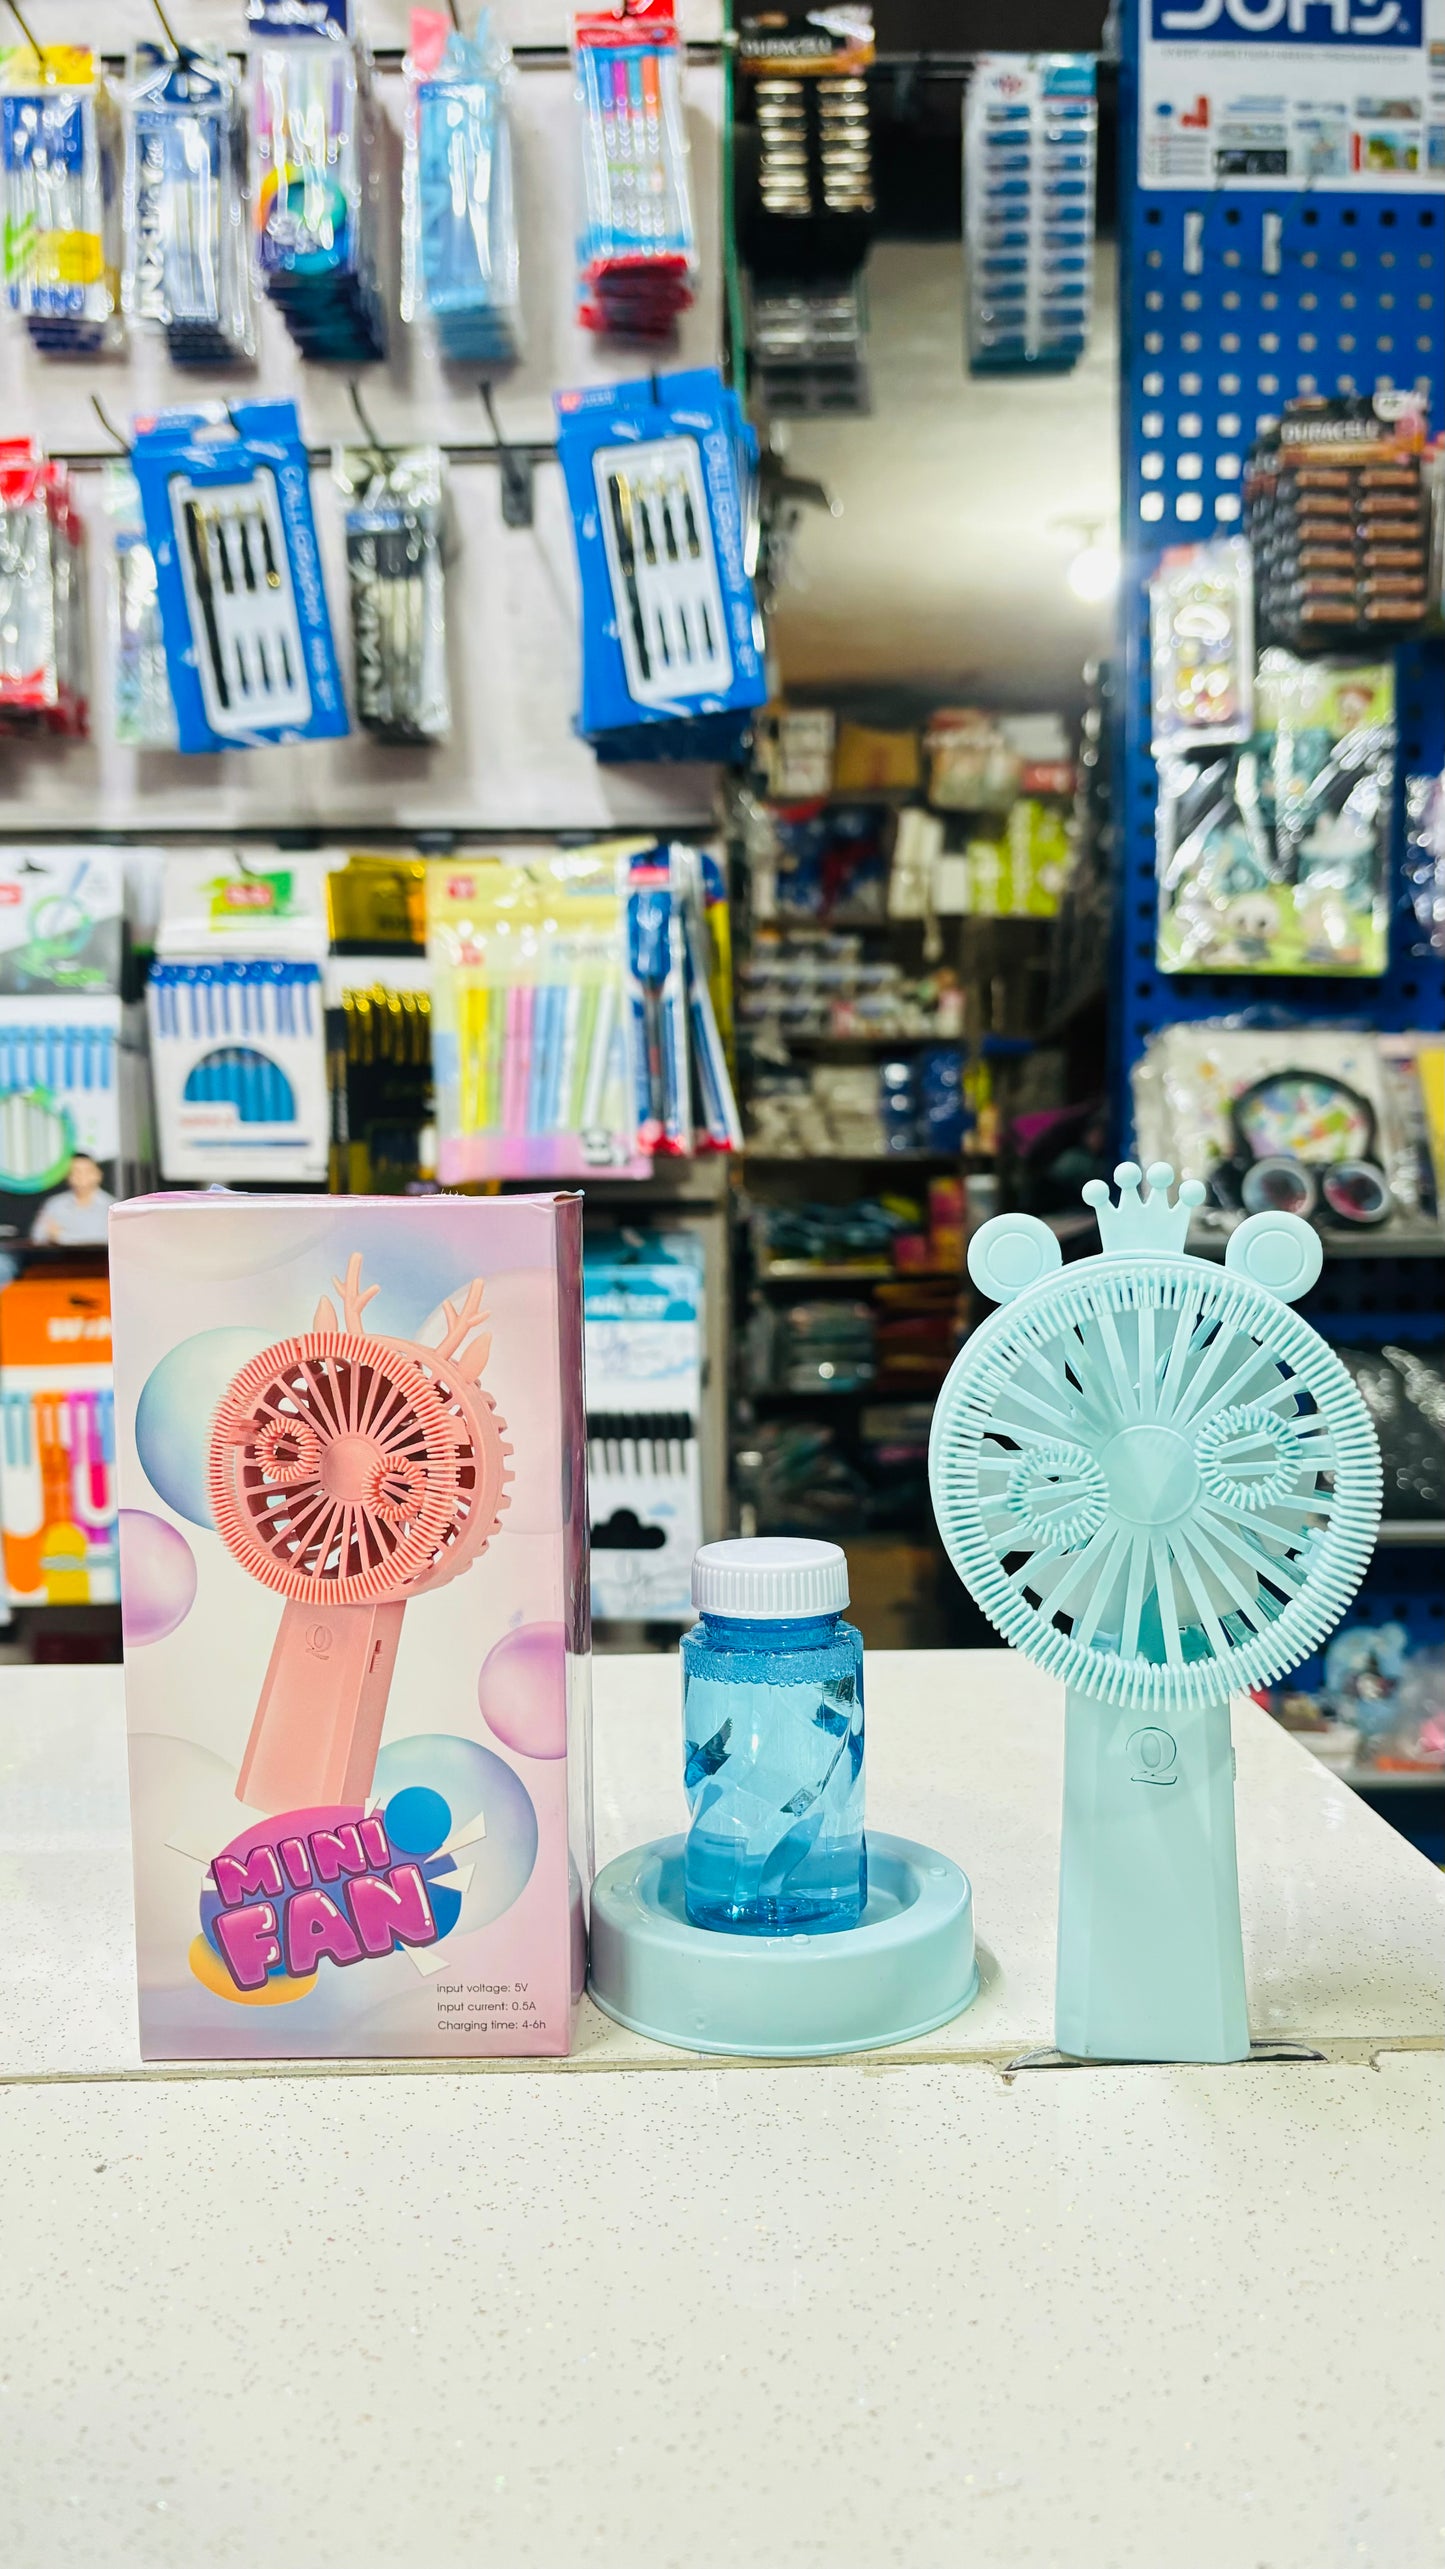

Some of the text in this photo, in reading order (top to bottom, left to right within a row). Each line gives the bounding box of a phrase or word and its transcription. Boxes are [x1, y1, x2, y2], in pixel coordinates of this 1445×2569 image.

[211, 1817, 391, 1907] MINI
[211, 1863, 438, 1991] FAN
[467, 1983, 511, 1994] voltage:
[514, 1983, 529, 1992] 5V
[437, 2001, 537, 2013] Input current: 0.5A
[437, 2020, 546, 2032] Charging time: 4-6h
